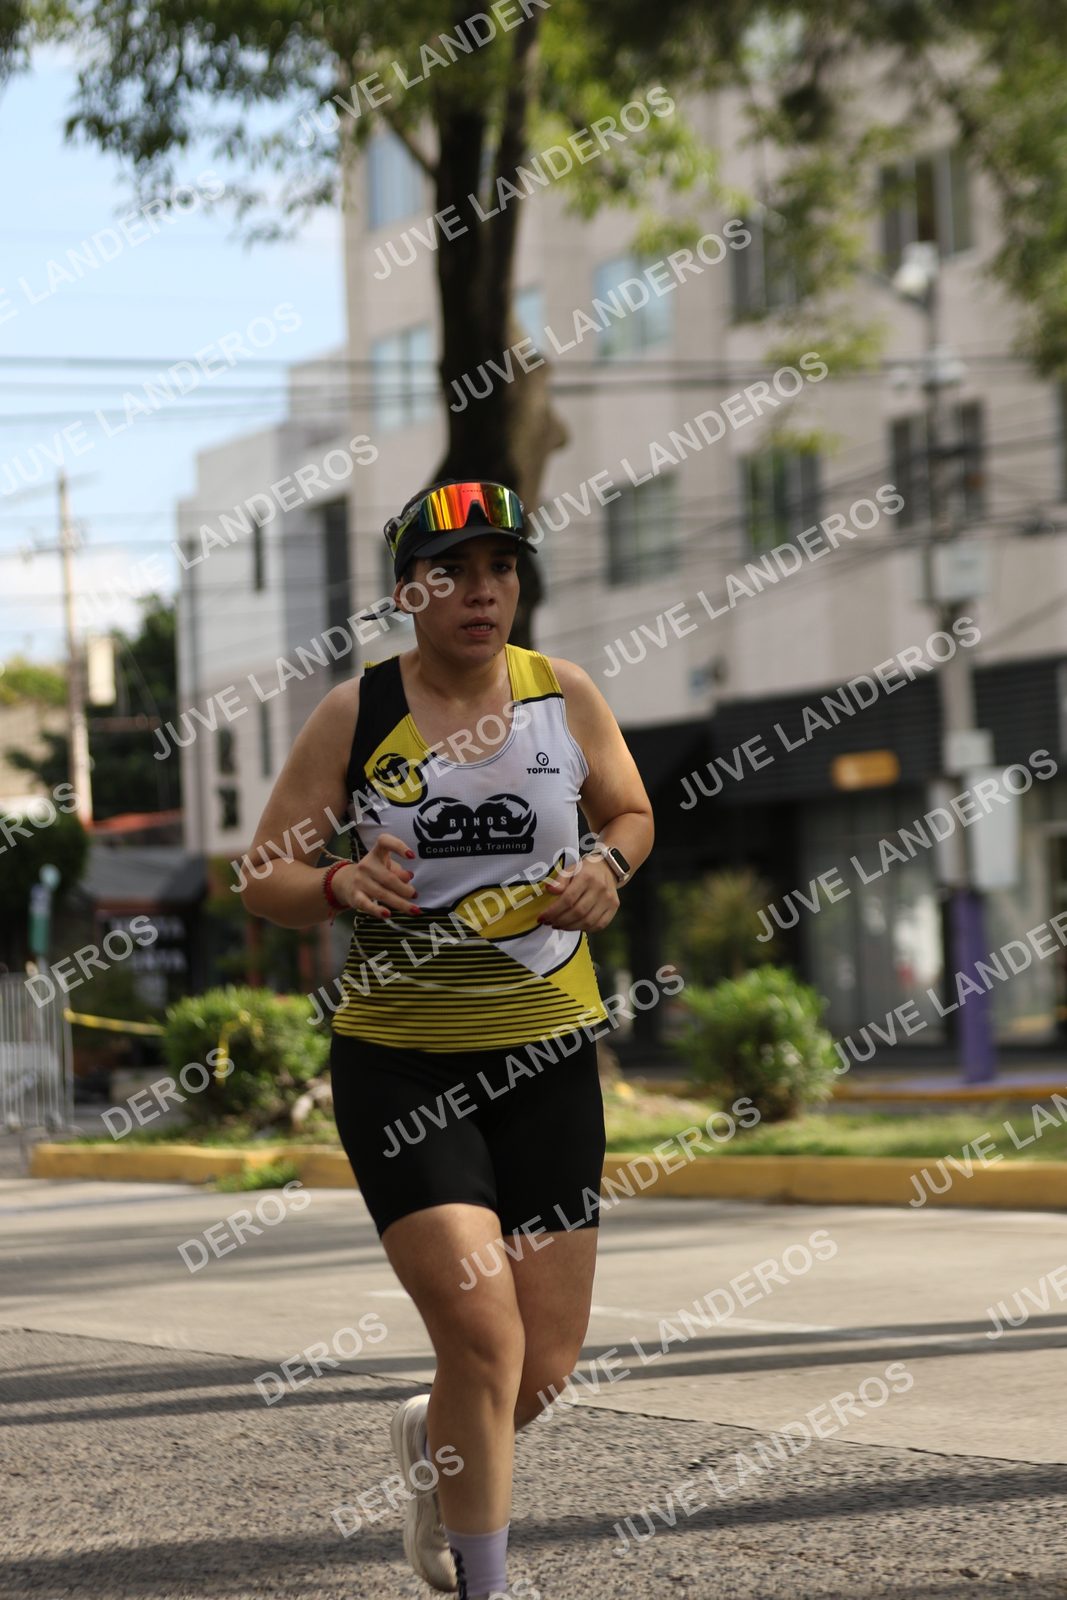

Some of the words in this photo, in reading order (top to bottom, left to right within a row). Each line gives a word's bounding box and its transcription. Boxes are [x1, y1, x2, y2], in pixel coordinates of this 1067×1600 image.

[449, 816, 507, 828] RINOS
[425, 844, 472, 855] Coaching
[487, 843, 527, 852] Training
